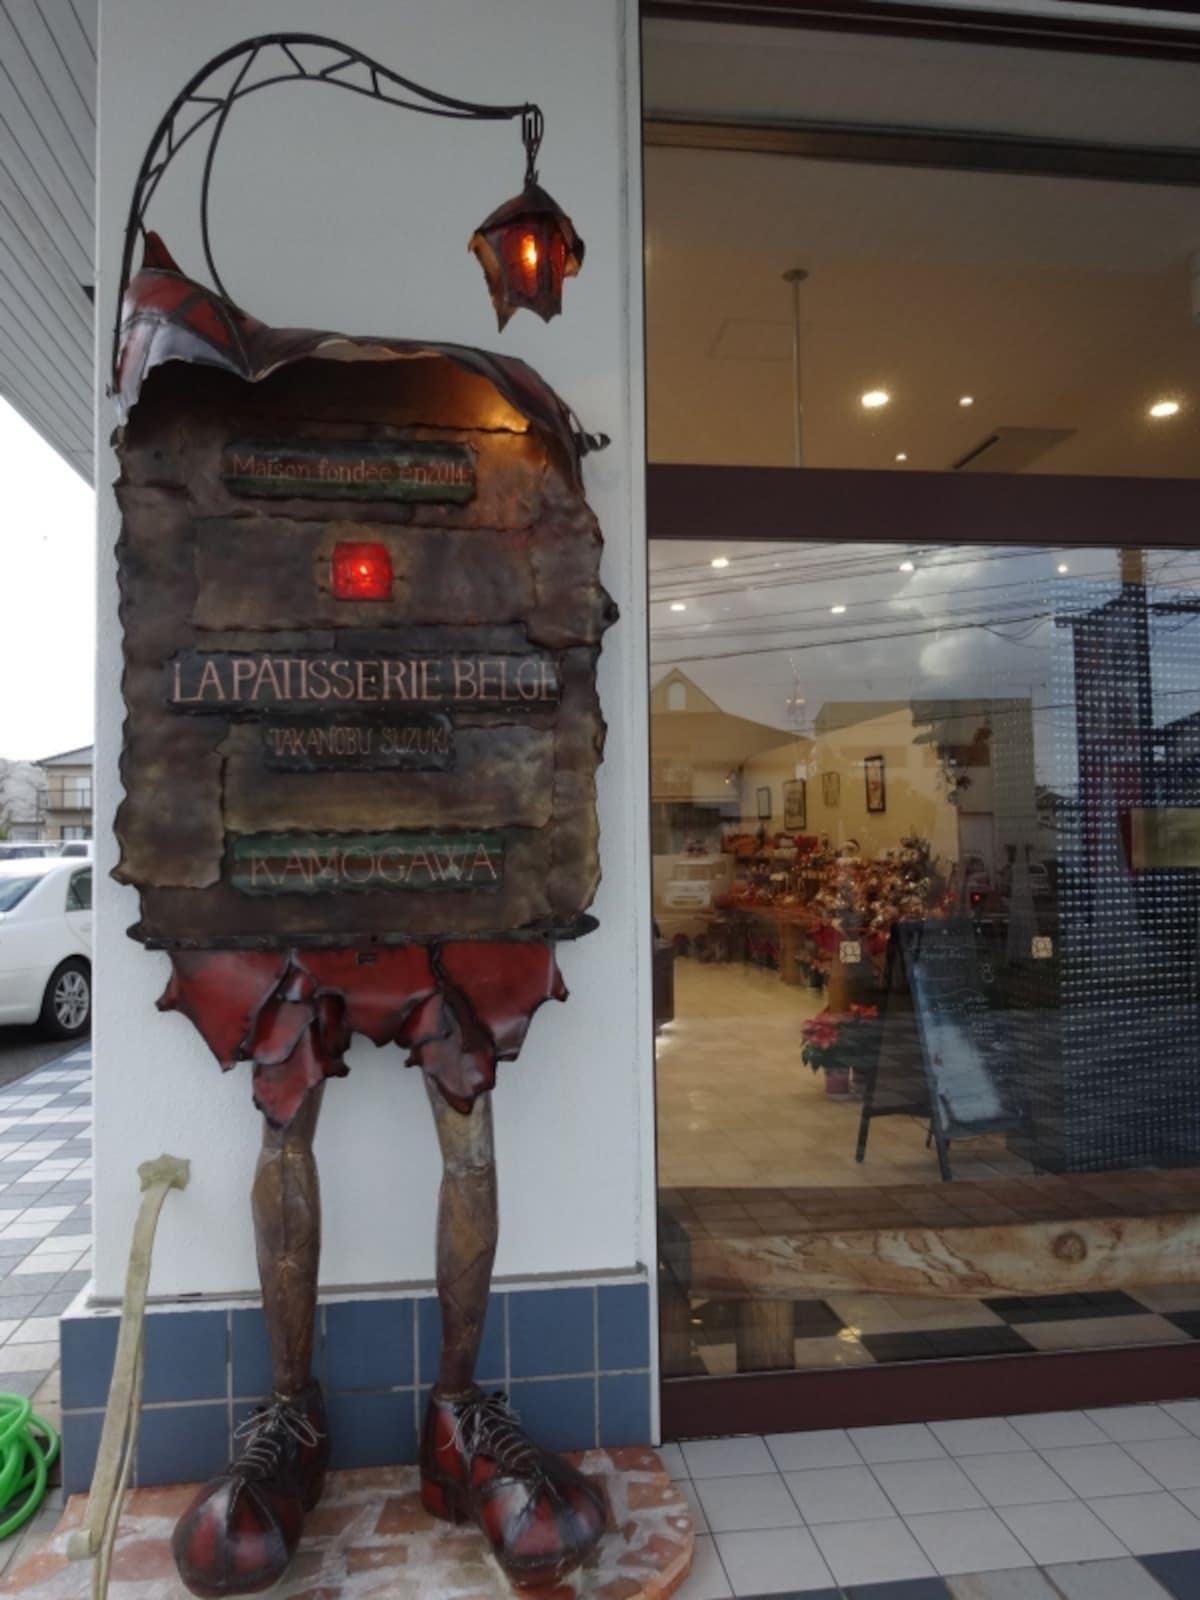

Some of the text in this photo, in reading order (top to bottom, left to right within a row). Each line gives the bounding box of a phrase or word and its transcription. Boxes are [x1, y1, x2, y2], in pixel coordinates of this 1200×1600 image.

[232, 454, 312, 480] Maison
[173, 659, 226, 702] LA
[452, 657, 560, 701] BELGE
[269, 727, 450, 756] TAKANOBU SUZUKI
[250, 843, 497, 885] KAMOGAWA
